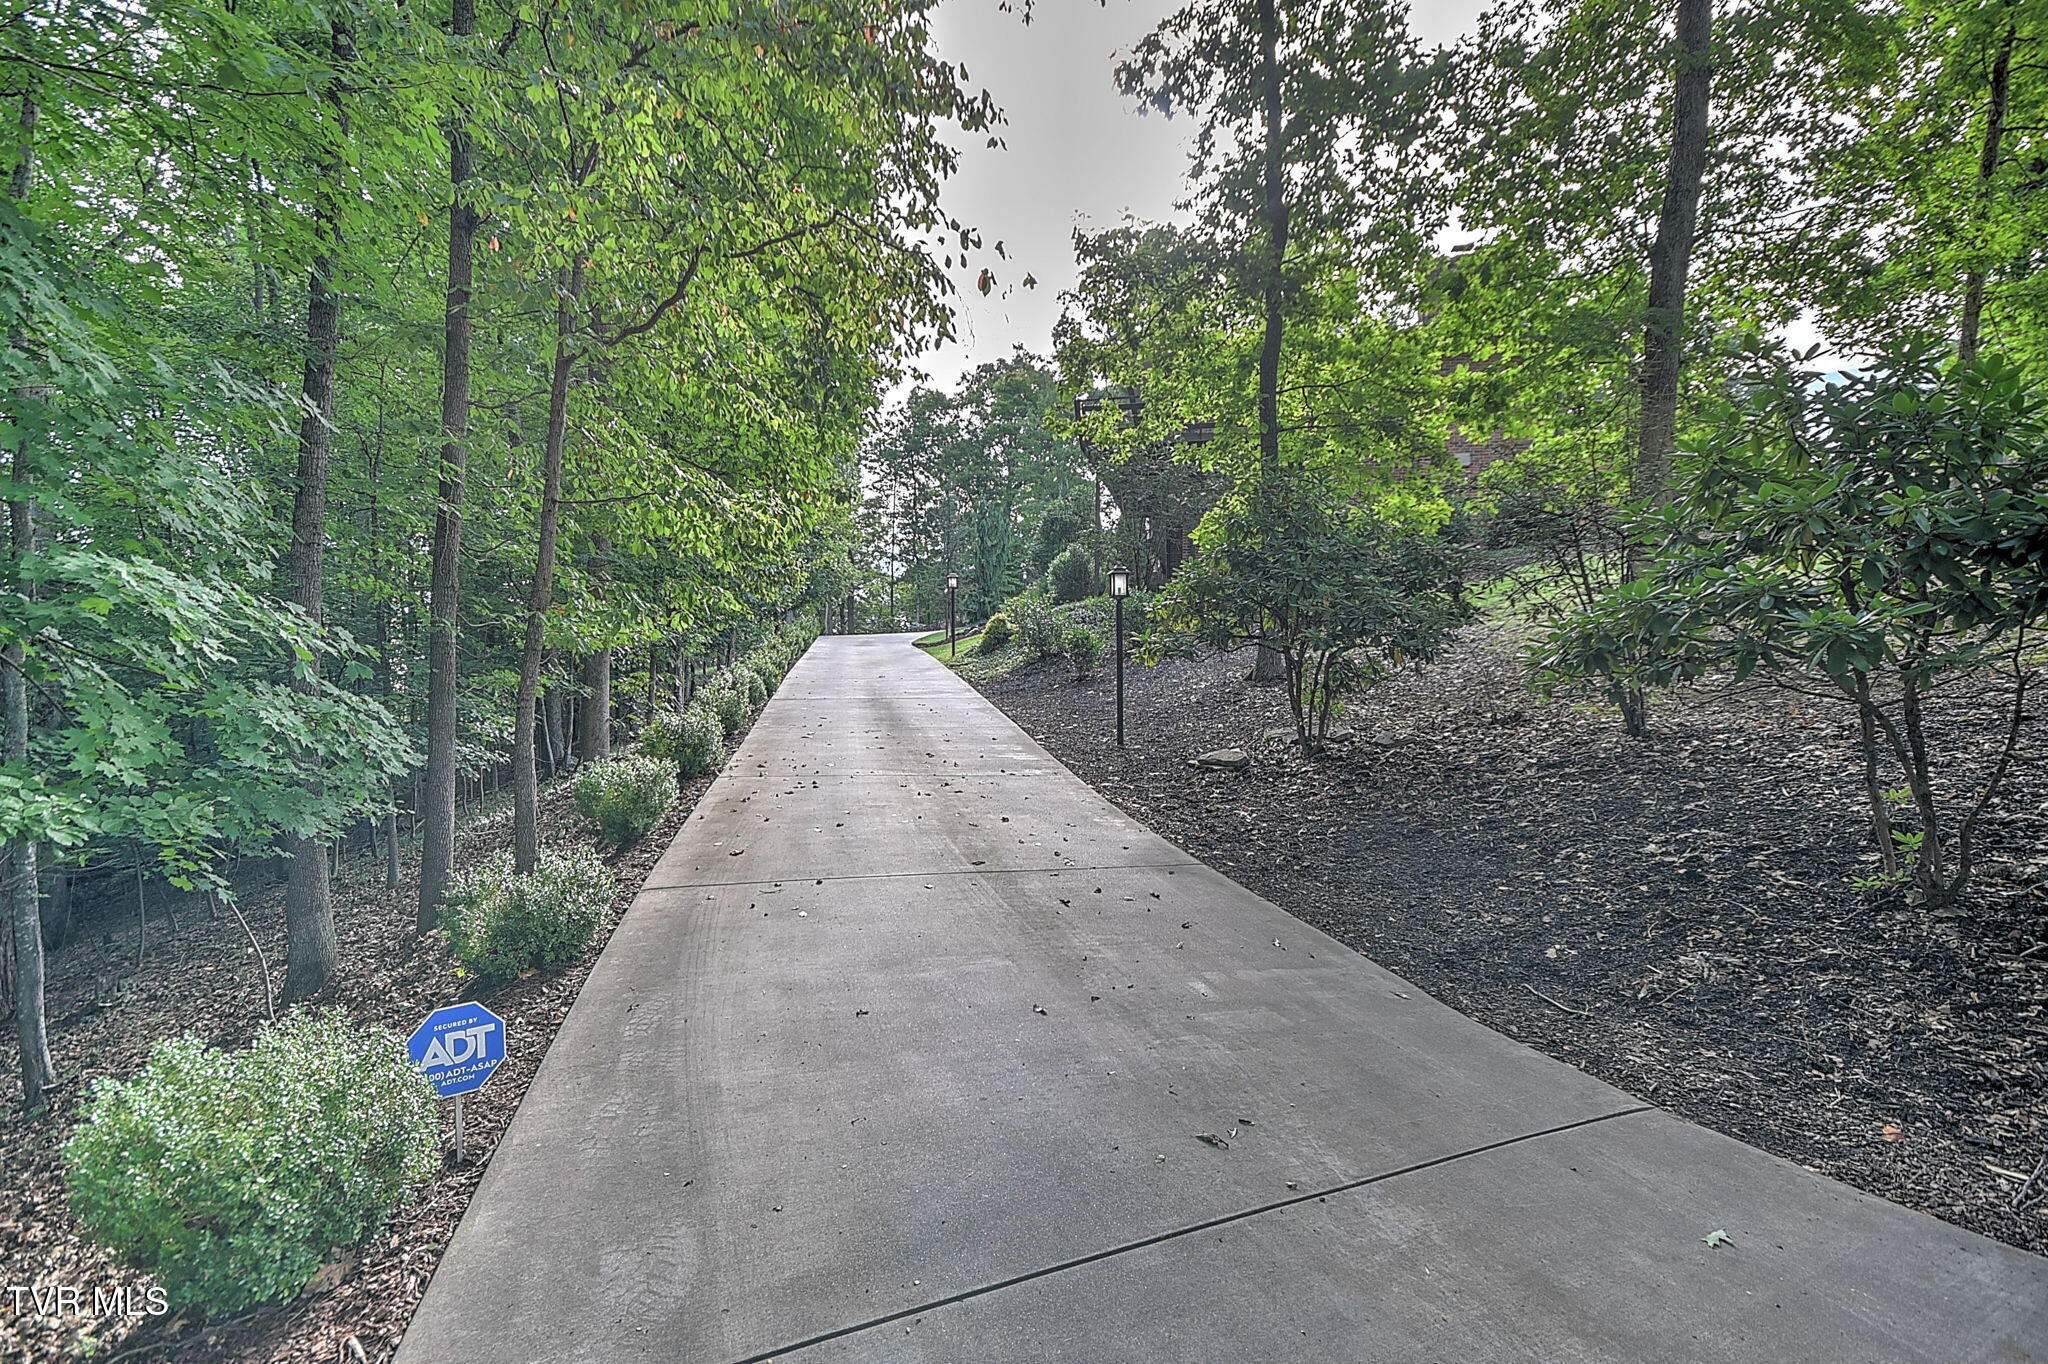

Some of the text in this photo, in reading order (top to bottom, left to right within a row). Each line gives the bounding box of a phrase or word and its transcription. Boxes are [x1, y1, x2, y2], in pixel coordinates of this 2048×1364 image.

[433, 1016, 478, 1032] SECURED BY
[419, 1023, 496, 1072] ADT
[441, 1073, 475, 1087] ADT.COM
